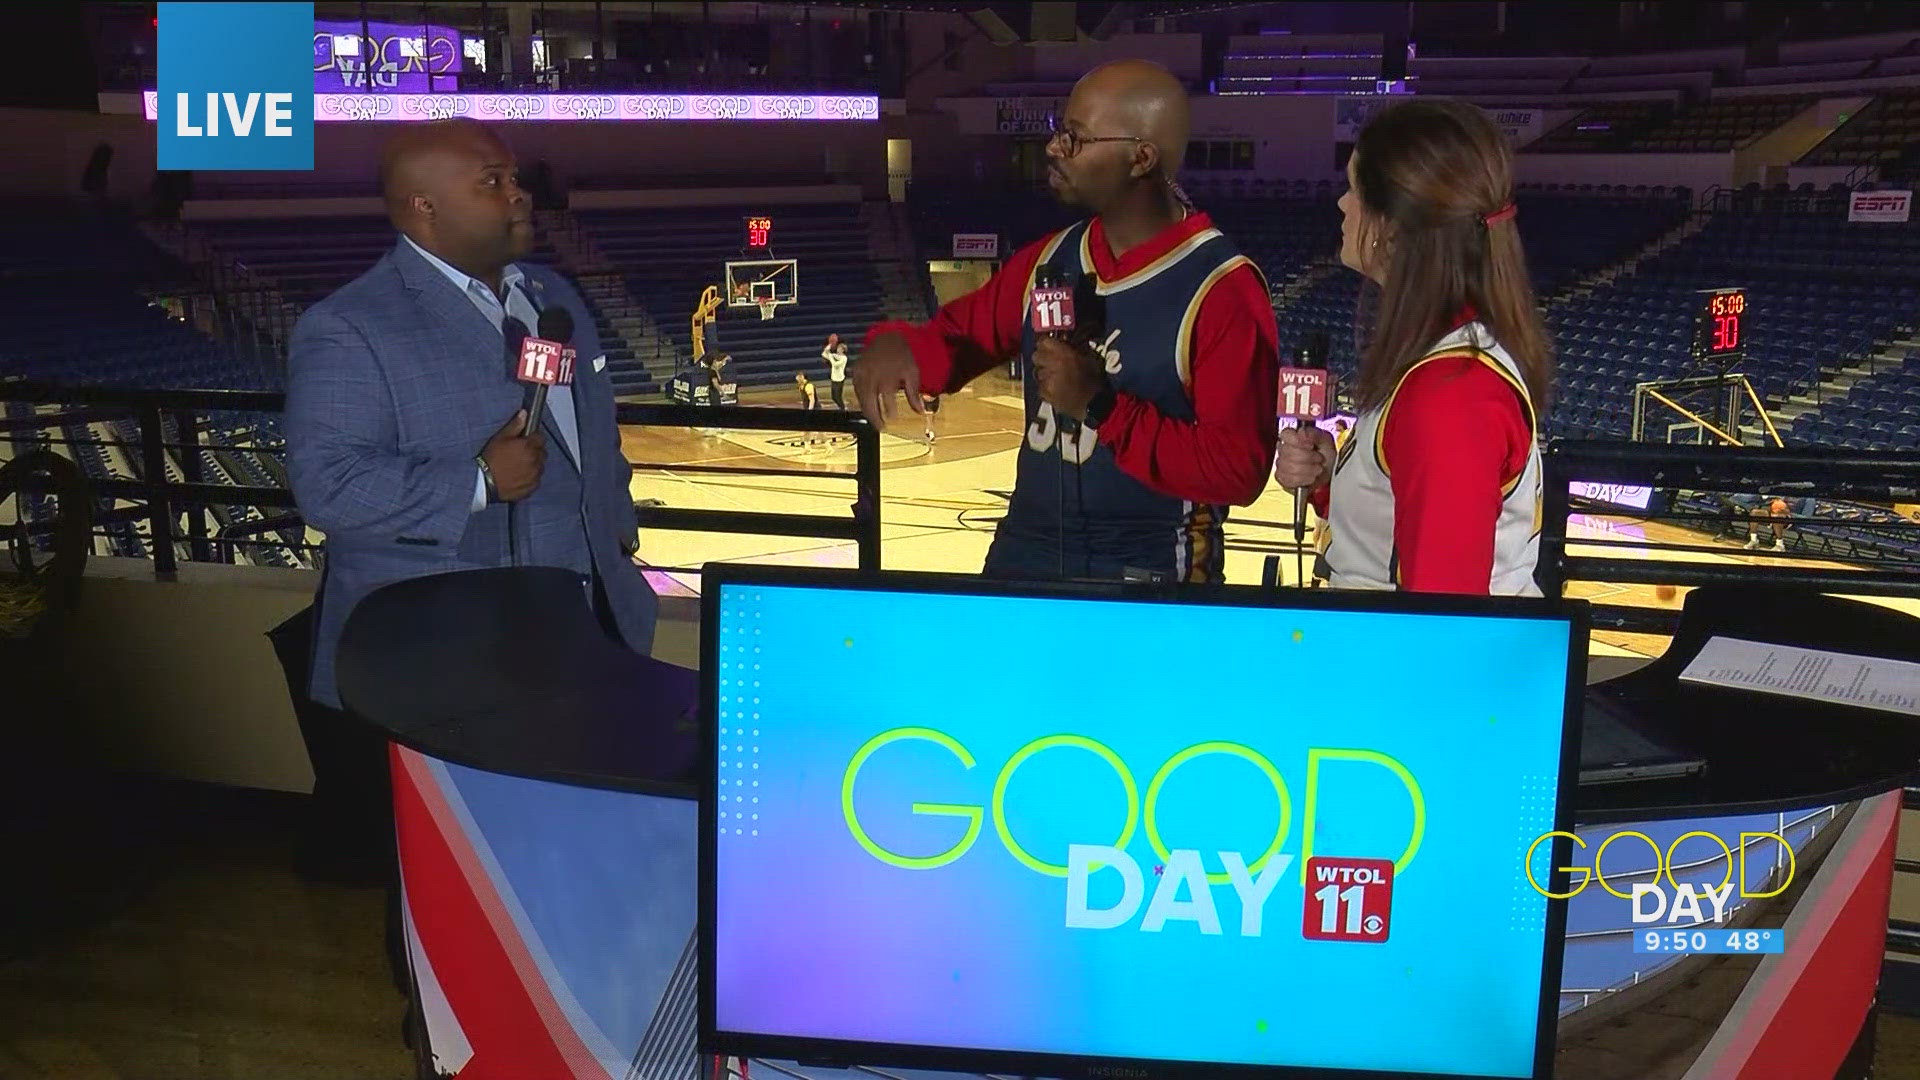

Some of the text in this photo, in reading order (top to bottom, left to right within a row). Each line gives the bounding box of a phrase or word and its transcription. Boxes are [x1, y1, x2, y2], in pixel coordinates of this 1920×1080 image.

[321, 95, 392, 116] GOOD
[350, 108, 377, 122] DAY
[402, 95, 470, 116] GOOD
[428, 108, 455, 122] DAY
[479, 95, 544, 116] GOOD
[504, 107, 531, 120] DAY
[553, 95, 615, 116] GOOD
[577, 107, 601, 120] DAY
[623, 95, 684, 116] GOOD
[647, 107, 671, 120] DAY
[692, 95, 751, 116] GOOD
[715, 107, 738, 120] DAY
[758, 95, 815, 116] GOOD
[780, 107, 803, 120] DAY
[822, 95, 877, 116] GOOD
[843, 107, 865, 120] DAY
[1854, 196, 1905, 213] ESPN
[750, 230, 767, 246] 30
[955, 238, 995, 252] ESPN
[1034, 291, 1070, 302] WTOL
[1710, 294, 1745, 315] 15:00
[1036, 301, 1062, 328] 11
[1713, 316, 1739, 351] 30
[526, 341, 558, 356] WTOL
[524, 351, 548, 380] 11
[1282, 373, 1322, 385] WTOL
[1282, 385, 1311, 415] 11
[1585, 483, 1623, 503] DAY
[842, 725, 1427, 886] GOOD
[1315, 866, 1387, 886] WTOL
[1065, 843, 1294, 937] DAY
[1314, 885, 1367, 935] 11
